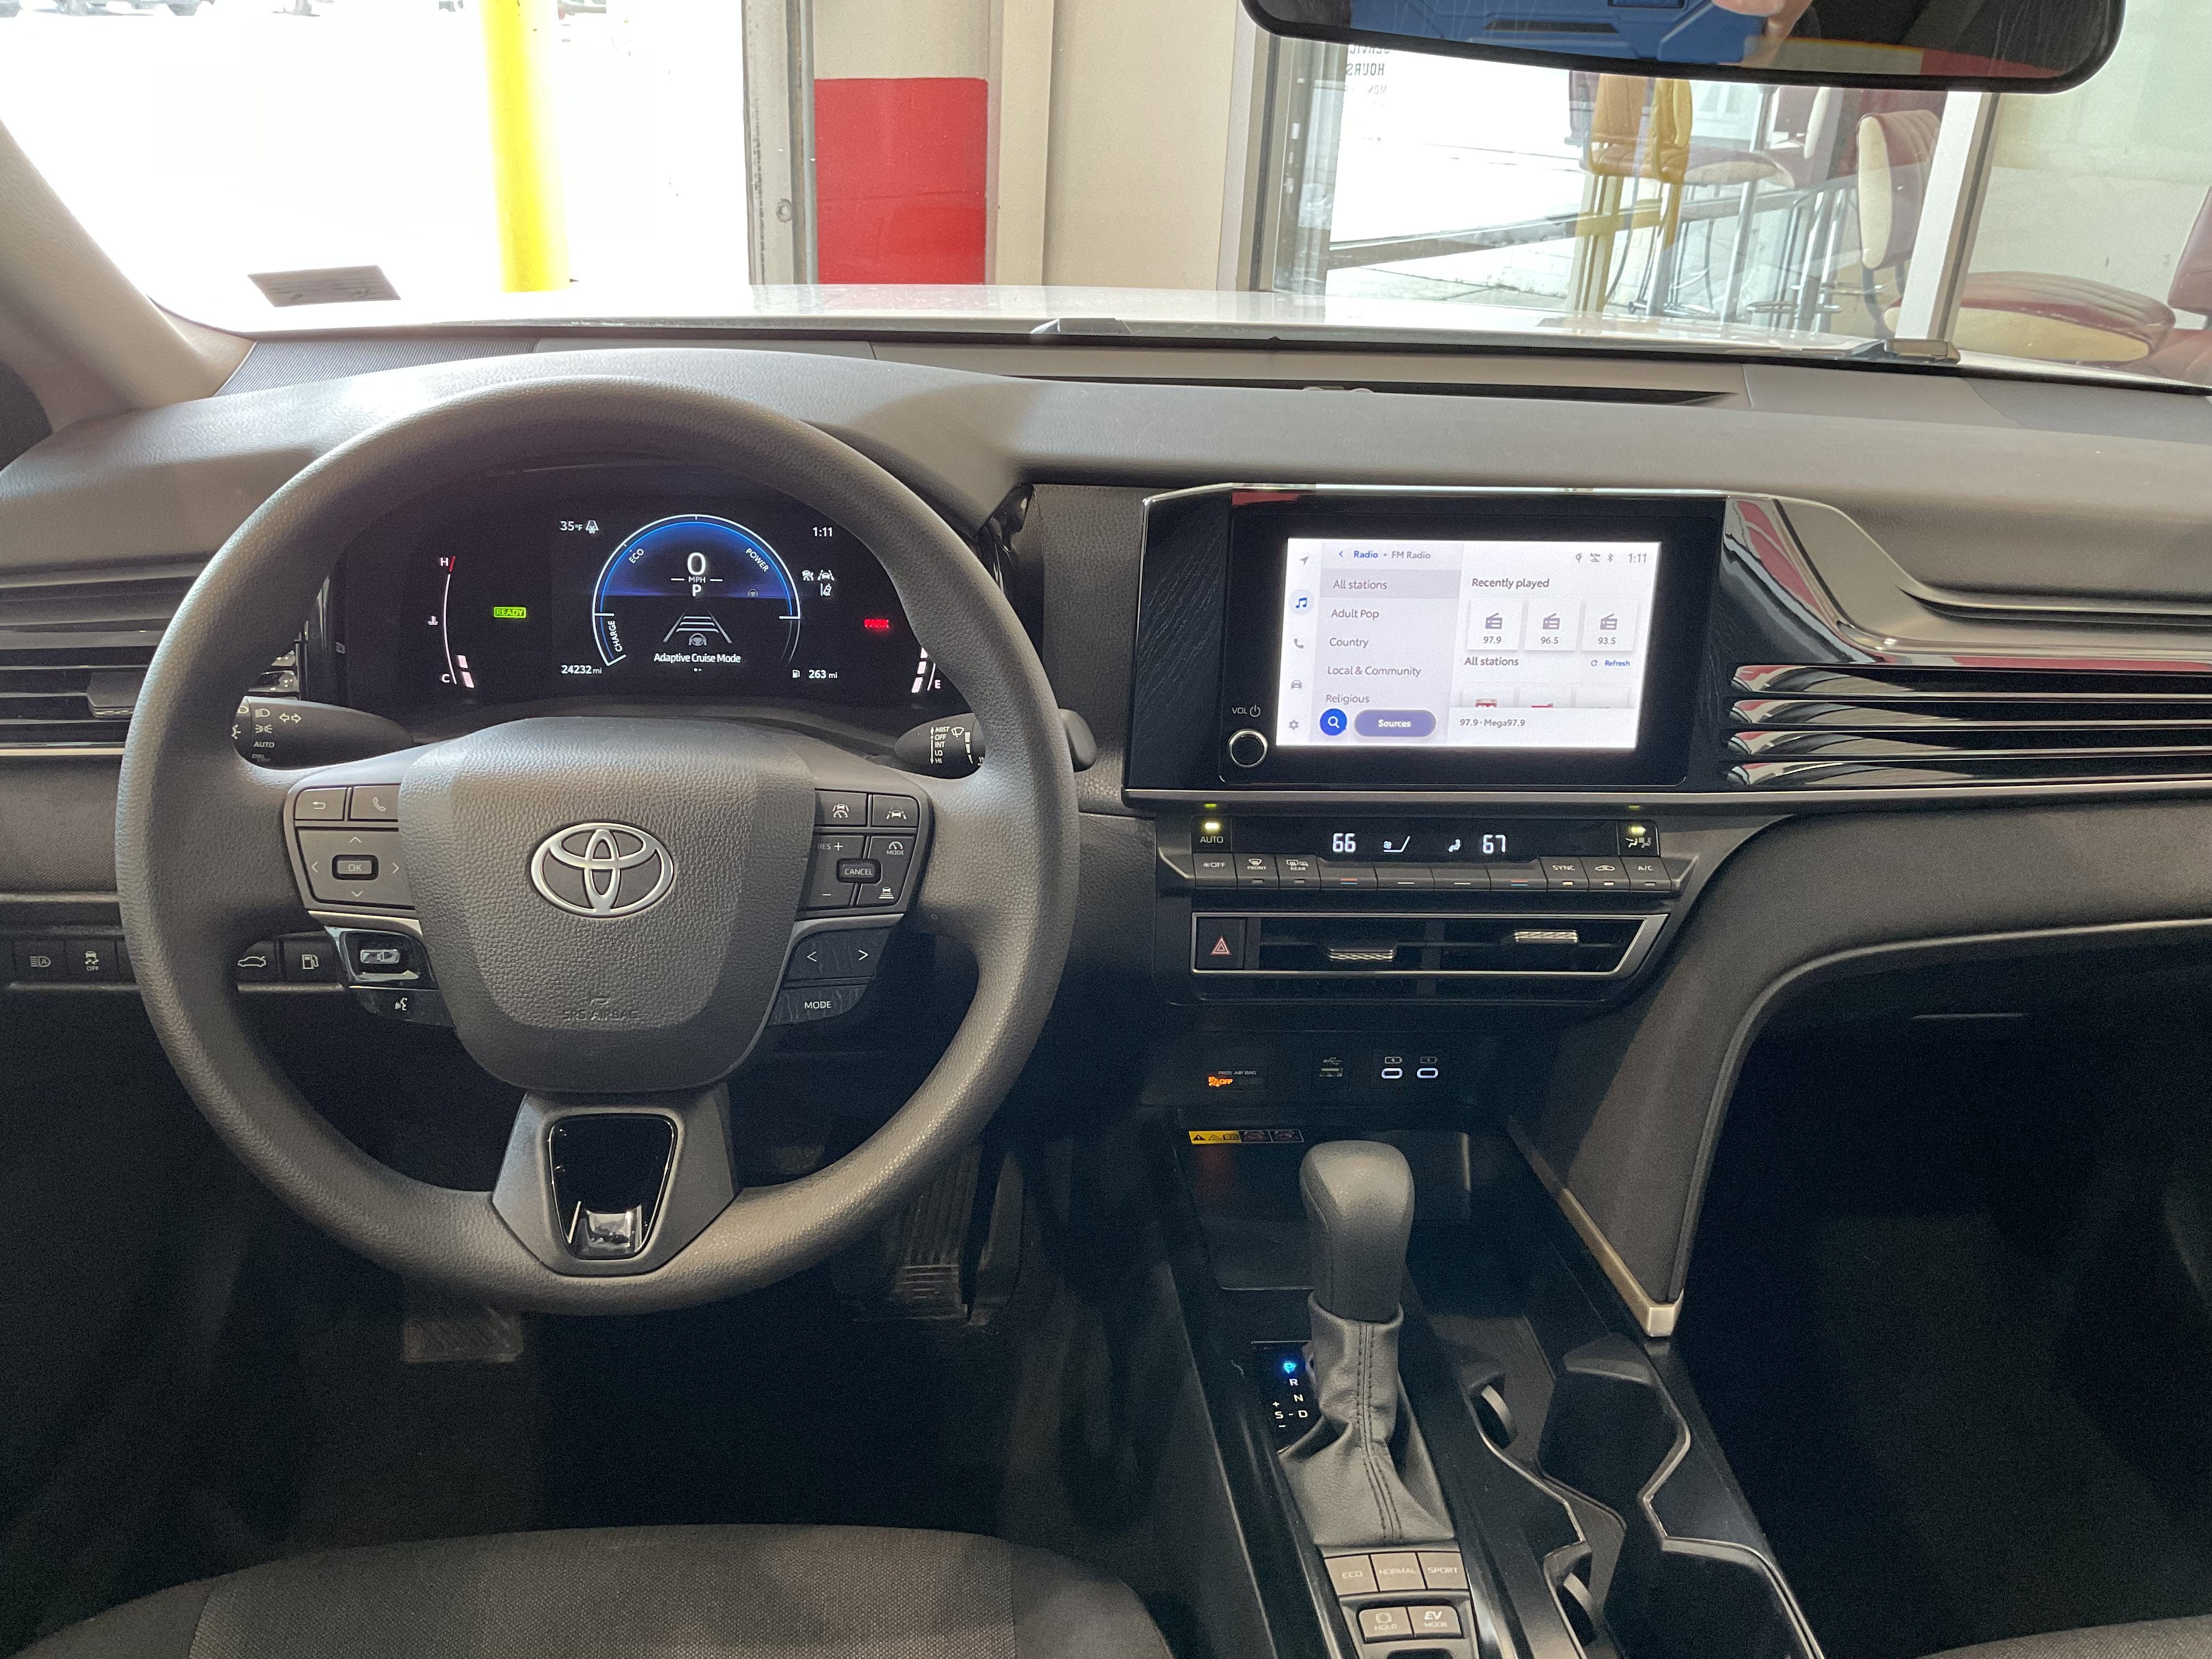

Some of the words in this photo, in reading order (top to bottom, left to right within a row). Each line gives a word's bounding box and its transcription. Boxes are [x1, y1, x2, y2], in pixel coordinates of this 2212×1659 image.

[813, 527, 832, 537] 1:11
[629, 549, 644, 563] ECO
[746, 548, 769, 572] POWER
[1628, 553, 1646, 563] 1:11
[441, 557, 449, 566] H
[687, 552, 706, 575] 0
[1333, 580, 1346, 589] All
[1348, 580, 1387, 589] stations
[1472, 579, 1514, 590] Recently
[1516, 579, 1550, 590] played
[692, 584, 702, 597] P
[1331, 609, 1358, 618] Adult
[1360, 610, 1379, 620] Pop
[608, 620, 623, 652] CHARGE
[1483, 636, 1502, 644] 97.9
[1541, 636, 1559, 645] 96.5
[1598, 637, 1616, 645] 93.5
[1329, 637, 1369, 648] Country
[654, 653, 691, 663] Adaptive
[692, 653, 715, 663] Cruise
[717, 653, 741, 663] Mode
[1464, 657, 1479, 665] All
[1480, 657, 1519, 666] stations
[561, 665, 592, 674] 24232
[809, 670, 827, 679] 263
[828, 670, 838, 679] mi
[1328, 666, 1353, 675] Local
[1355, 667, 1363, 675] &
[1365, 667, 1421, 677] Community
[442, 674, 450, 682] C
[934, 680, 941, 689] E
[1325, 694, 1370, 704] Religious
[1333, 833, 1356, 853] 66
[1482, 834, 1506, 854] 67
[804, 1001, 832, 1009] MODE
[1298, 1410, 1308, 1418] D
[1341, 1570, 1363, 1579] ECO
[1379, 1566, 1417, 1576] NORMAL
[1424, 1611, 1443, 1620] EV
